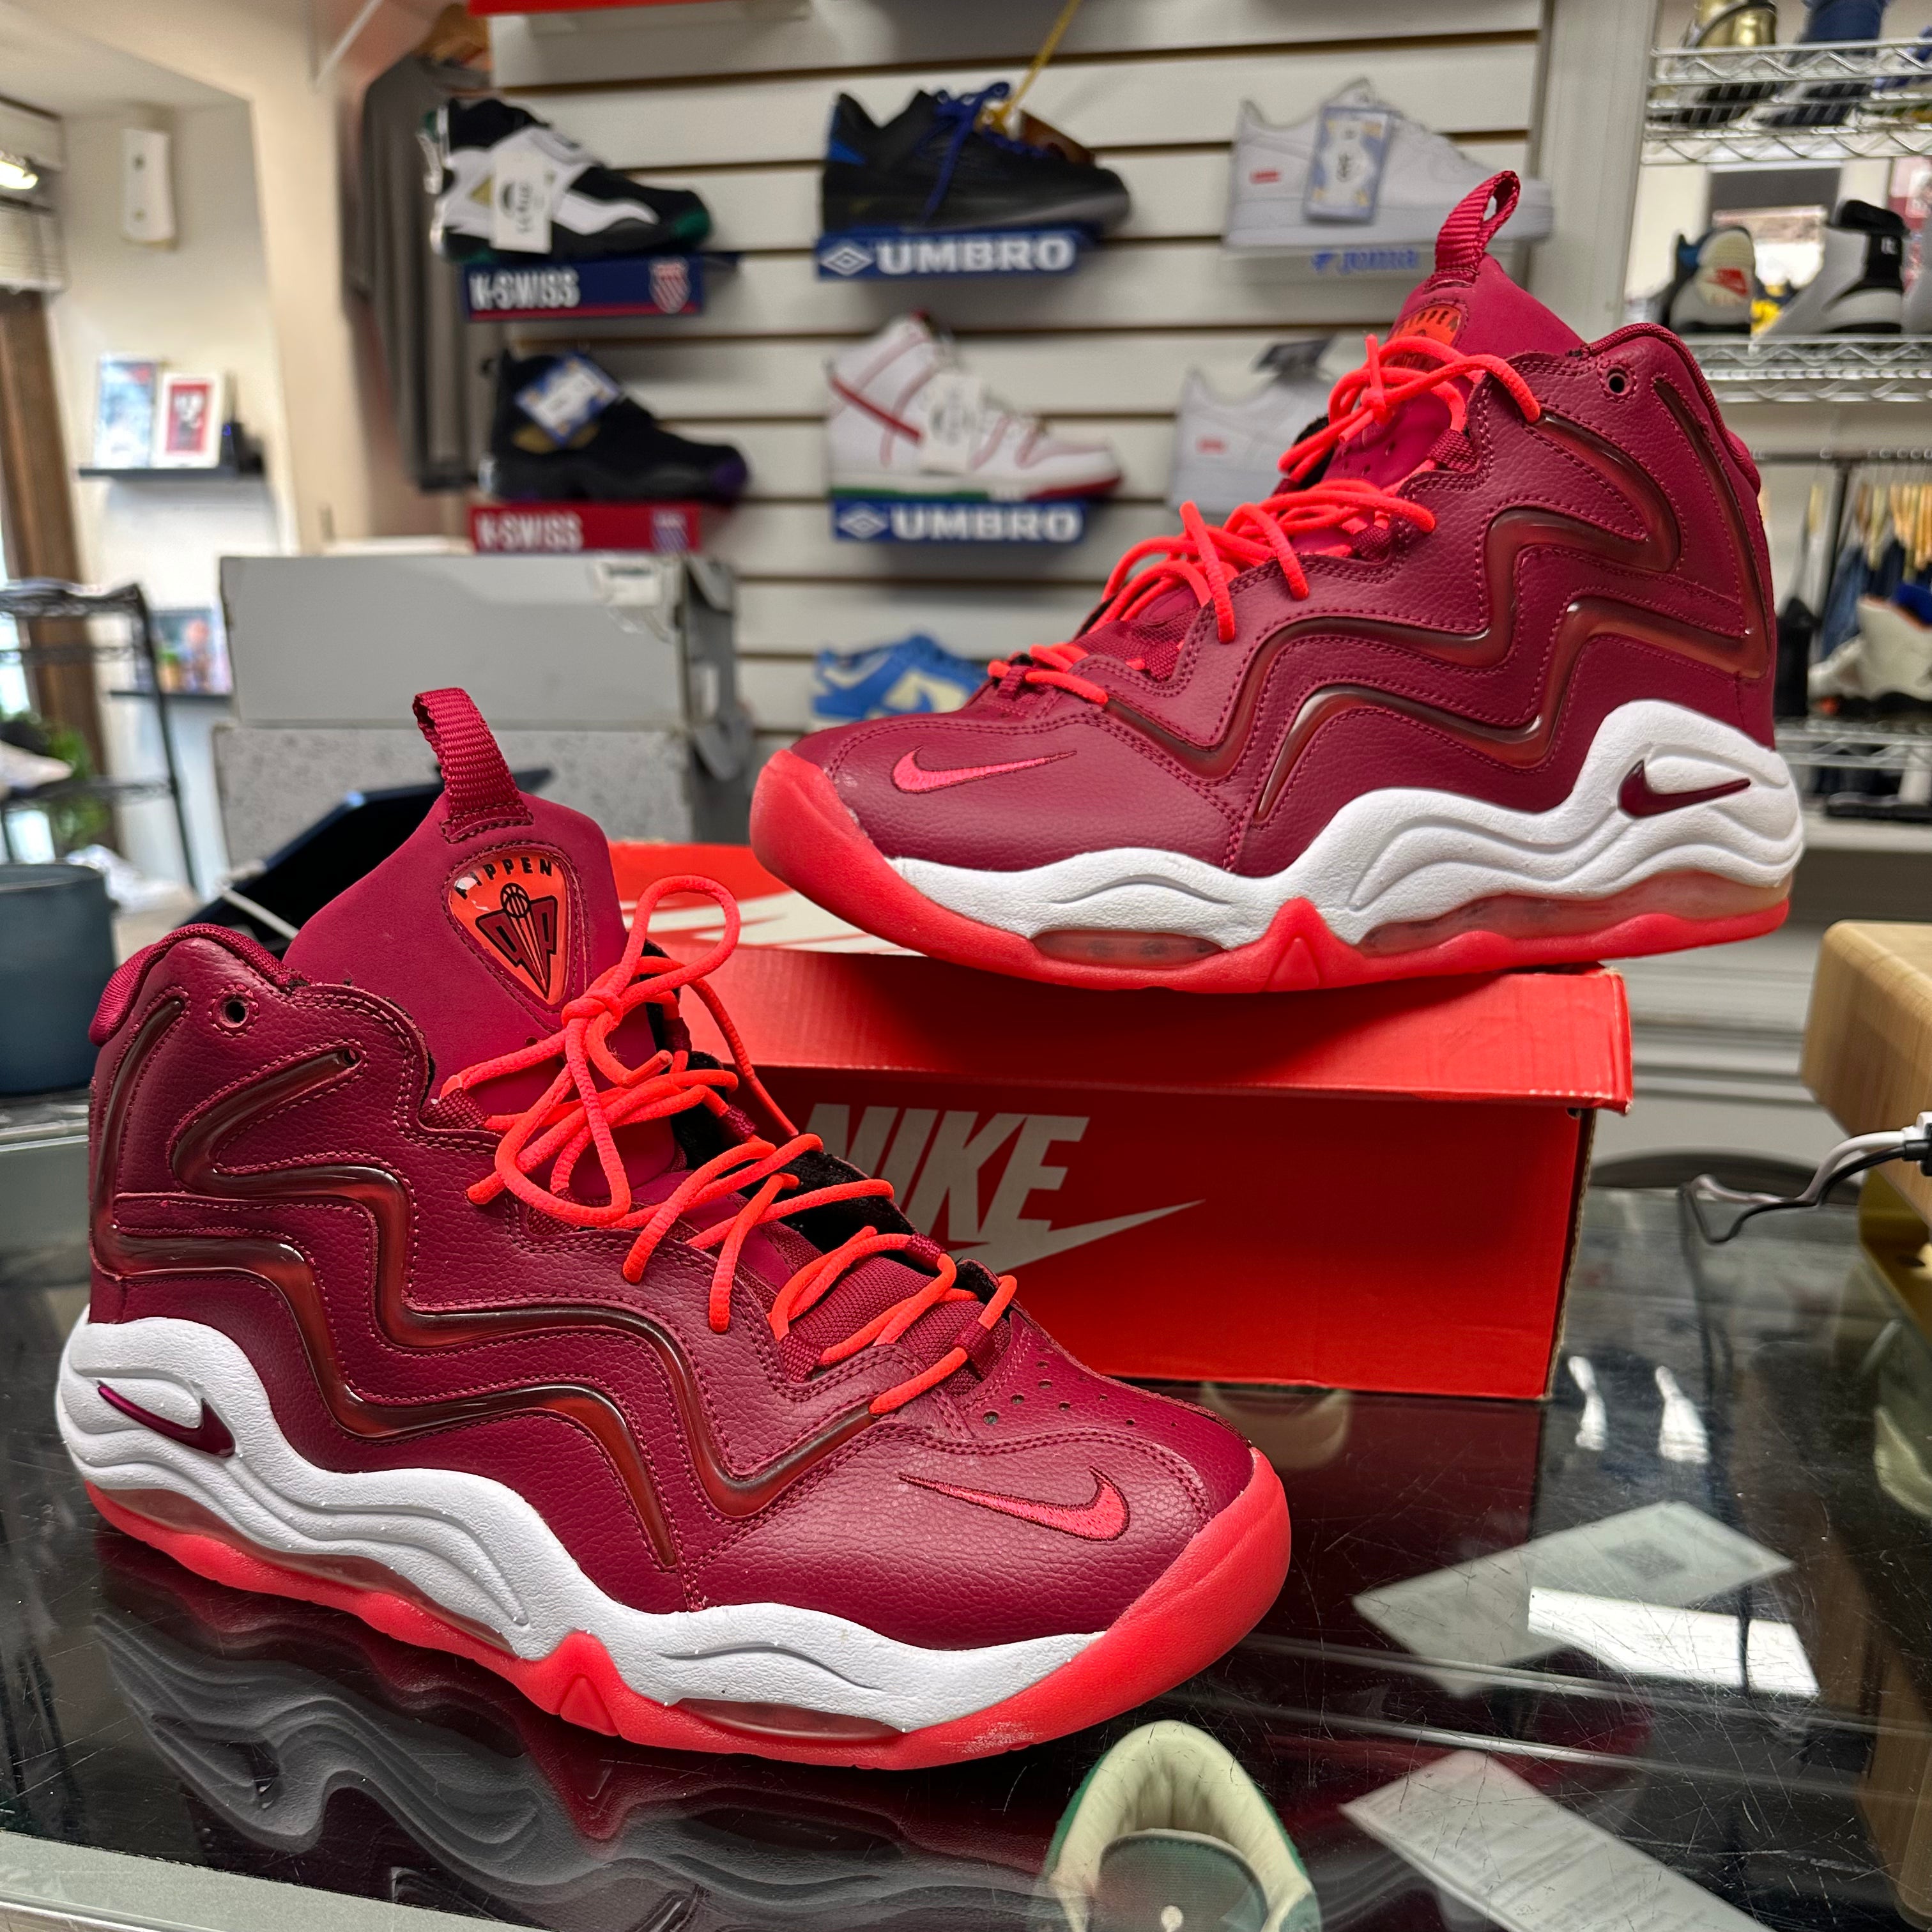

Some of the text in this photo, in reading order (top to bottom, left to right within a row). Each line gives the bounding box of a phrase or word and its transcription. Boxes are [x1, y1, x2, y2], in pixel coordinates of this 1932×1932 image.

[875, 237, 1077, 275] UMBRO
[469, 268, 581, 310] K-SWISS
[475, 512, 584, 551] K-SWISS
[891, 503, 1084, 542] UMBRO
[806, 1103, 1089, 1243] NIKE
